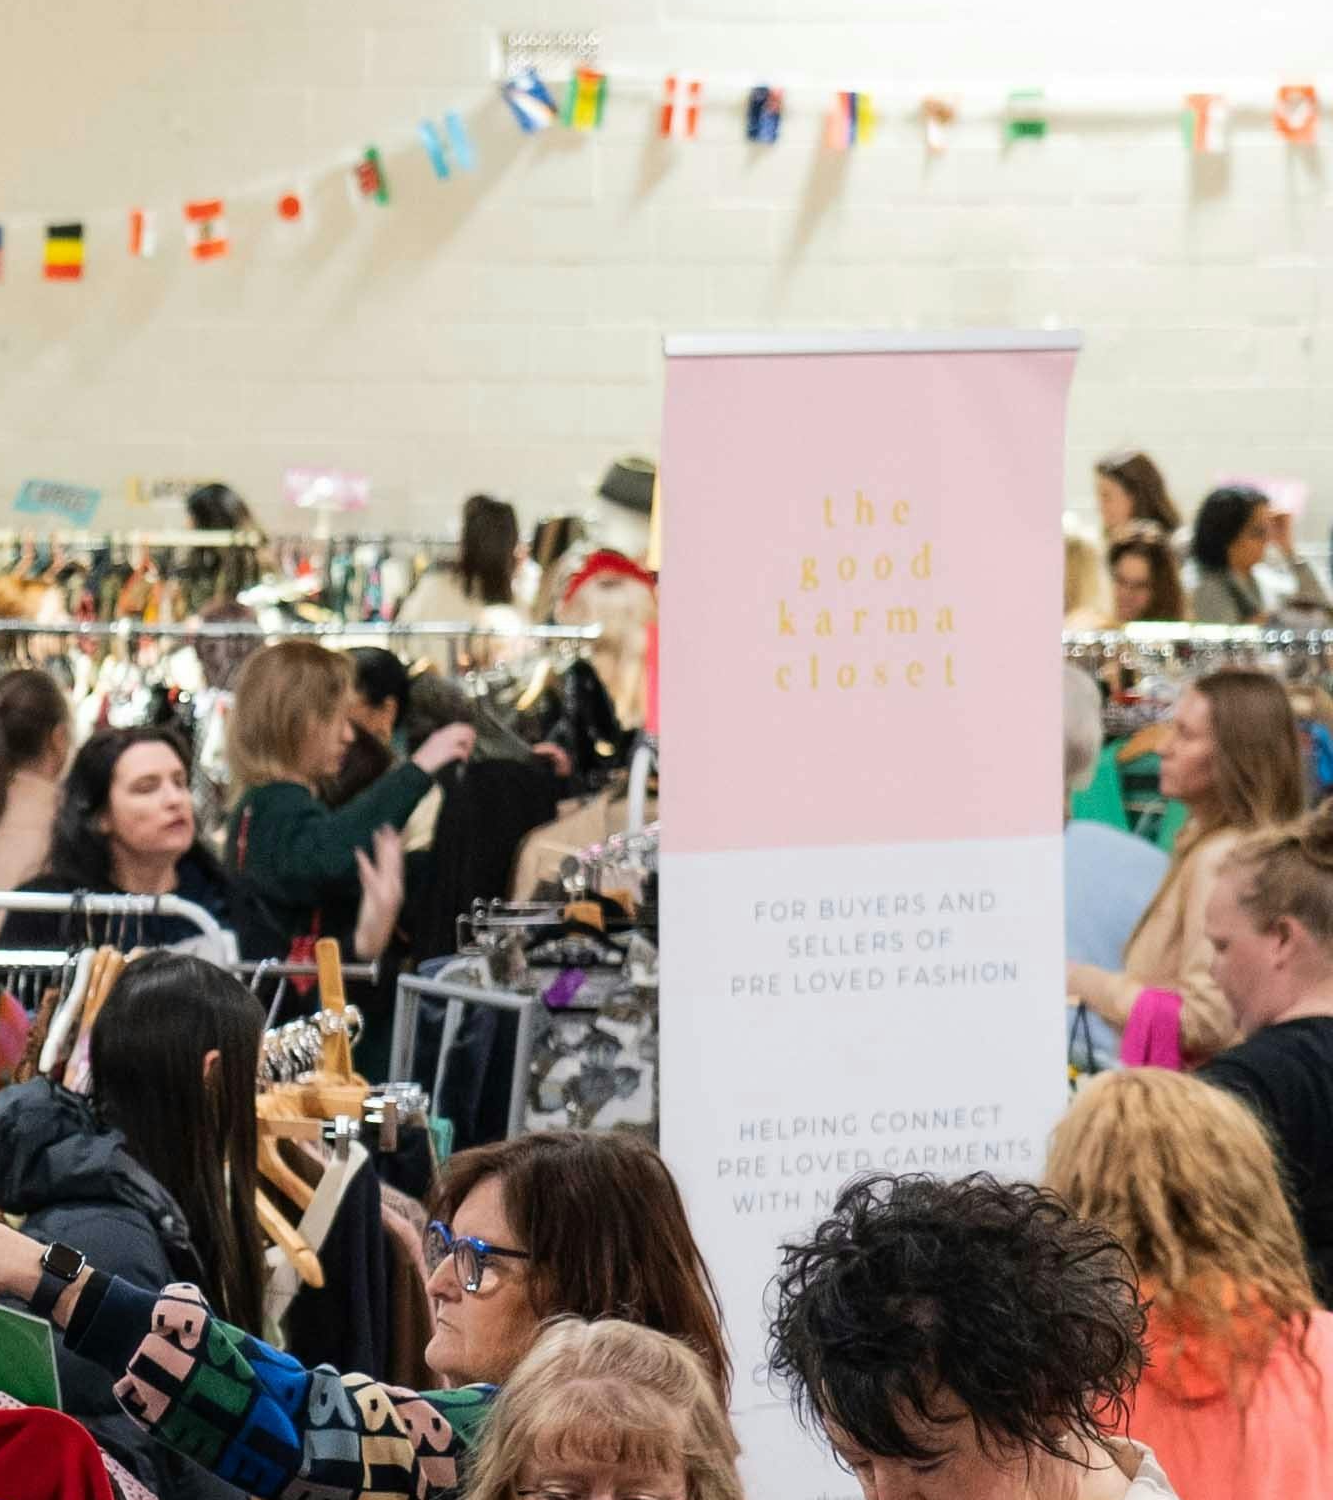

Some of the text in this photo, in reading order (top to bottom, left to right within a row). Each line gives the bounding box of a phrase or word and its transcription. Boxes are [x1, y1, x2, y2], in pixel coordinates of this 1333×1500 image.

[822, 488, 910, 529] the
[799, 540, 931, 591] good
[778, 599, 954, 636] karma
[774, 653, 957, 691] closet
[753, 891, 997, 924] FOR BUYERS AND
[788, 927, 953, 958] SELLERS OF
[731, 962, 1018, 997] PRE LOVED FASHION
[739, 1104, 1003, 1142] HELPING CONNECT
[717, 1138, 1033, 1179] PRE LOVED GARMENTS
[732, 1190, 800, 1215] WITH
